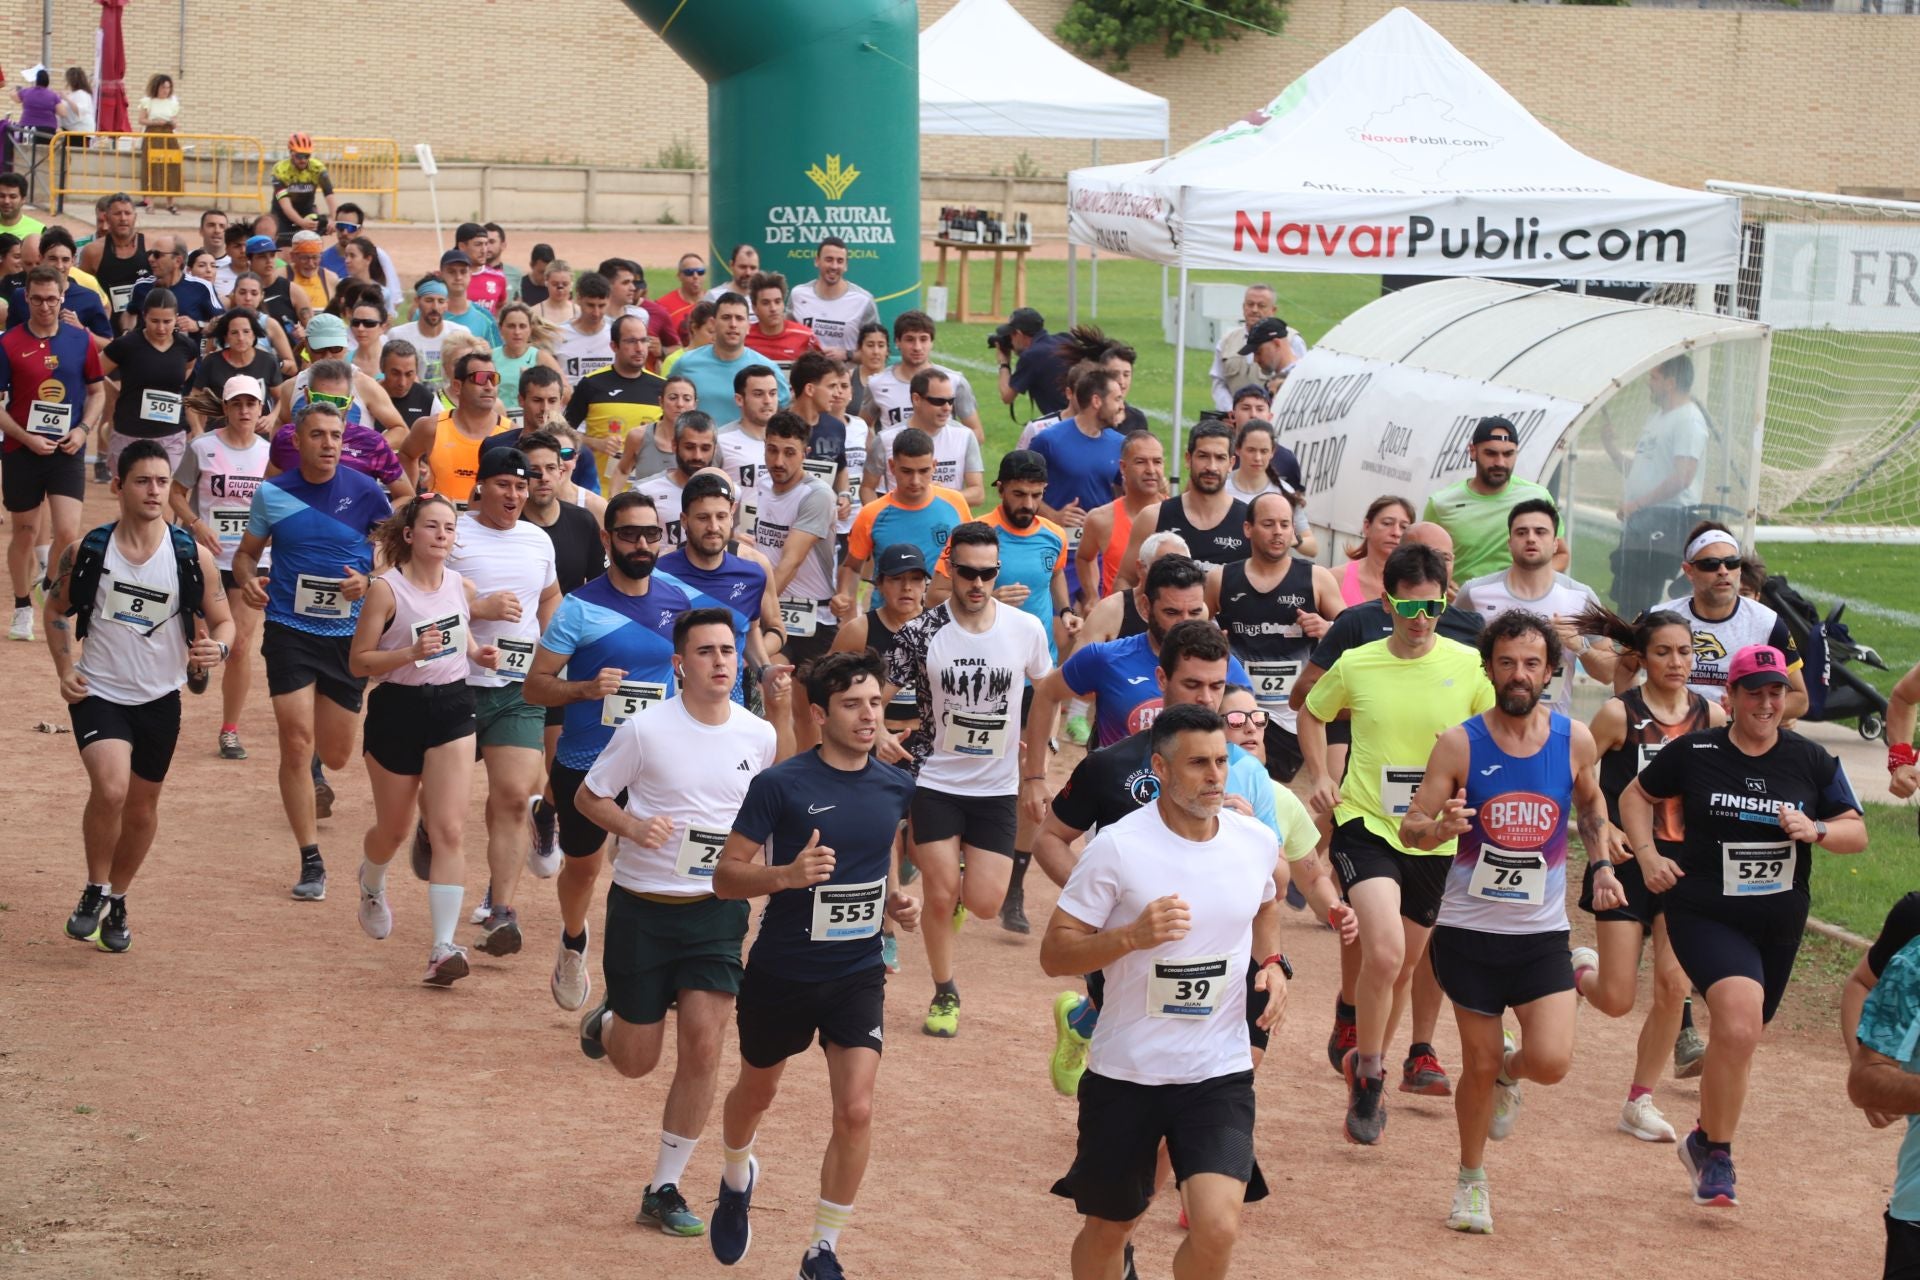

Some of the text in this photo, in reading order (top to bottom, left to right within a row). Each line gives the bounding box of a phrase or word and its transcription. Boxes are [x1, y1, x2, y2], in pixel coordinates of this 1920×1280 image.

[1360, 132, 1489, 148] NavarPubli.com
[768, 206, 892, 226] CAJA RURAL
[765, 226, 896, 244] DE NAVARRA
[1232, 209, 1688, 264] NavarPubli.com
[787, 249, 880, 259] ACCI OCIAL
[150, 401, 174, 413] 505
[42, 413, 60, 426] 66
[229, 490, 253, 499] ALFA
[759, 536, 784, 549] ALFAR
[131, 598, 144, 612] 8
[313, 591, 337, 605] 32
[506, 652, 525, 668] 42
[953, 658, 987, 667] TRAIL
[1261, 677, 1284, 692] 62
[624, 698, 647, 714] 51
[967, 730, 990, 745] 14
[1710, 792, 1796, 815] FINISHER
[1491, 801, 1553, 831] BENIS
[1715, 810, 1739, 818] CROSS
[1494, 868, 1522, 886] 76
[1738, 861, 1783, 879] 529
[829, 902, 875, 923] 553
[1175, 979, 1210, 1000] 39
